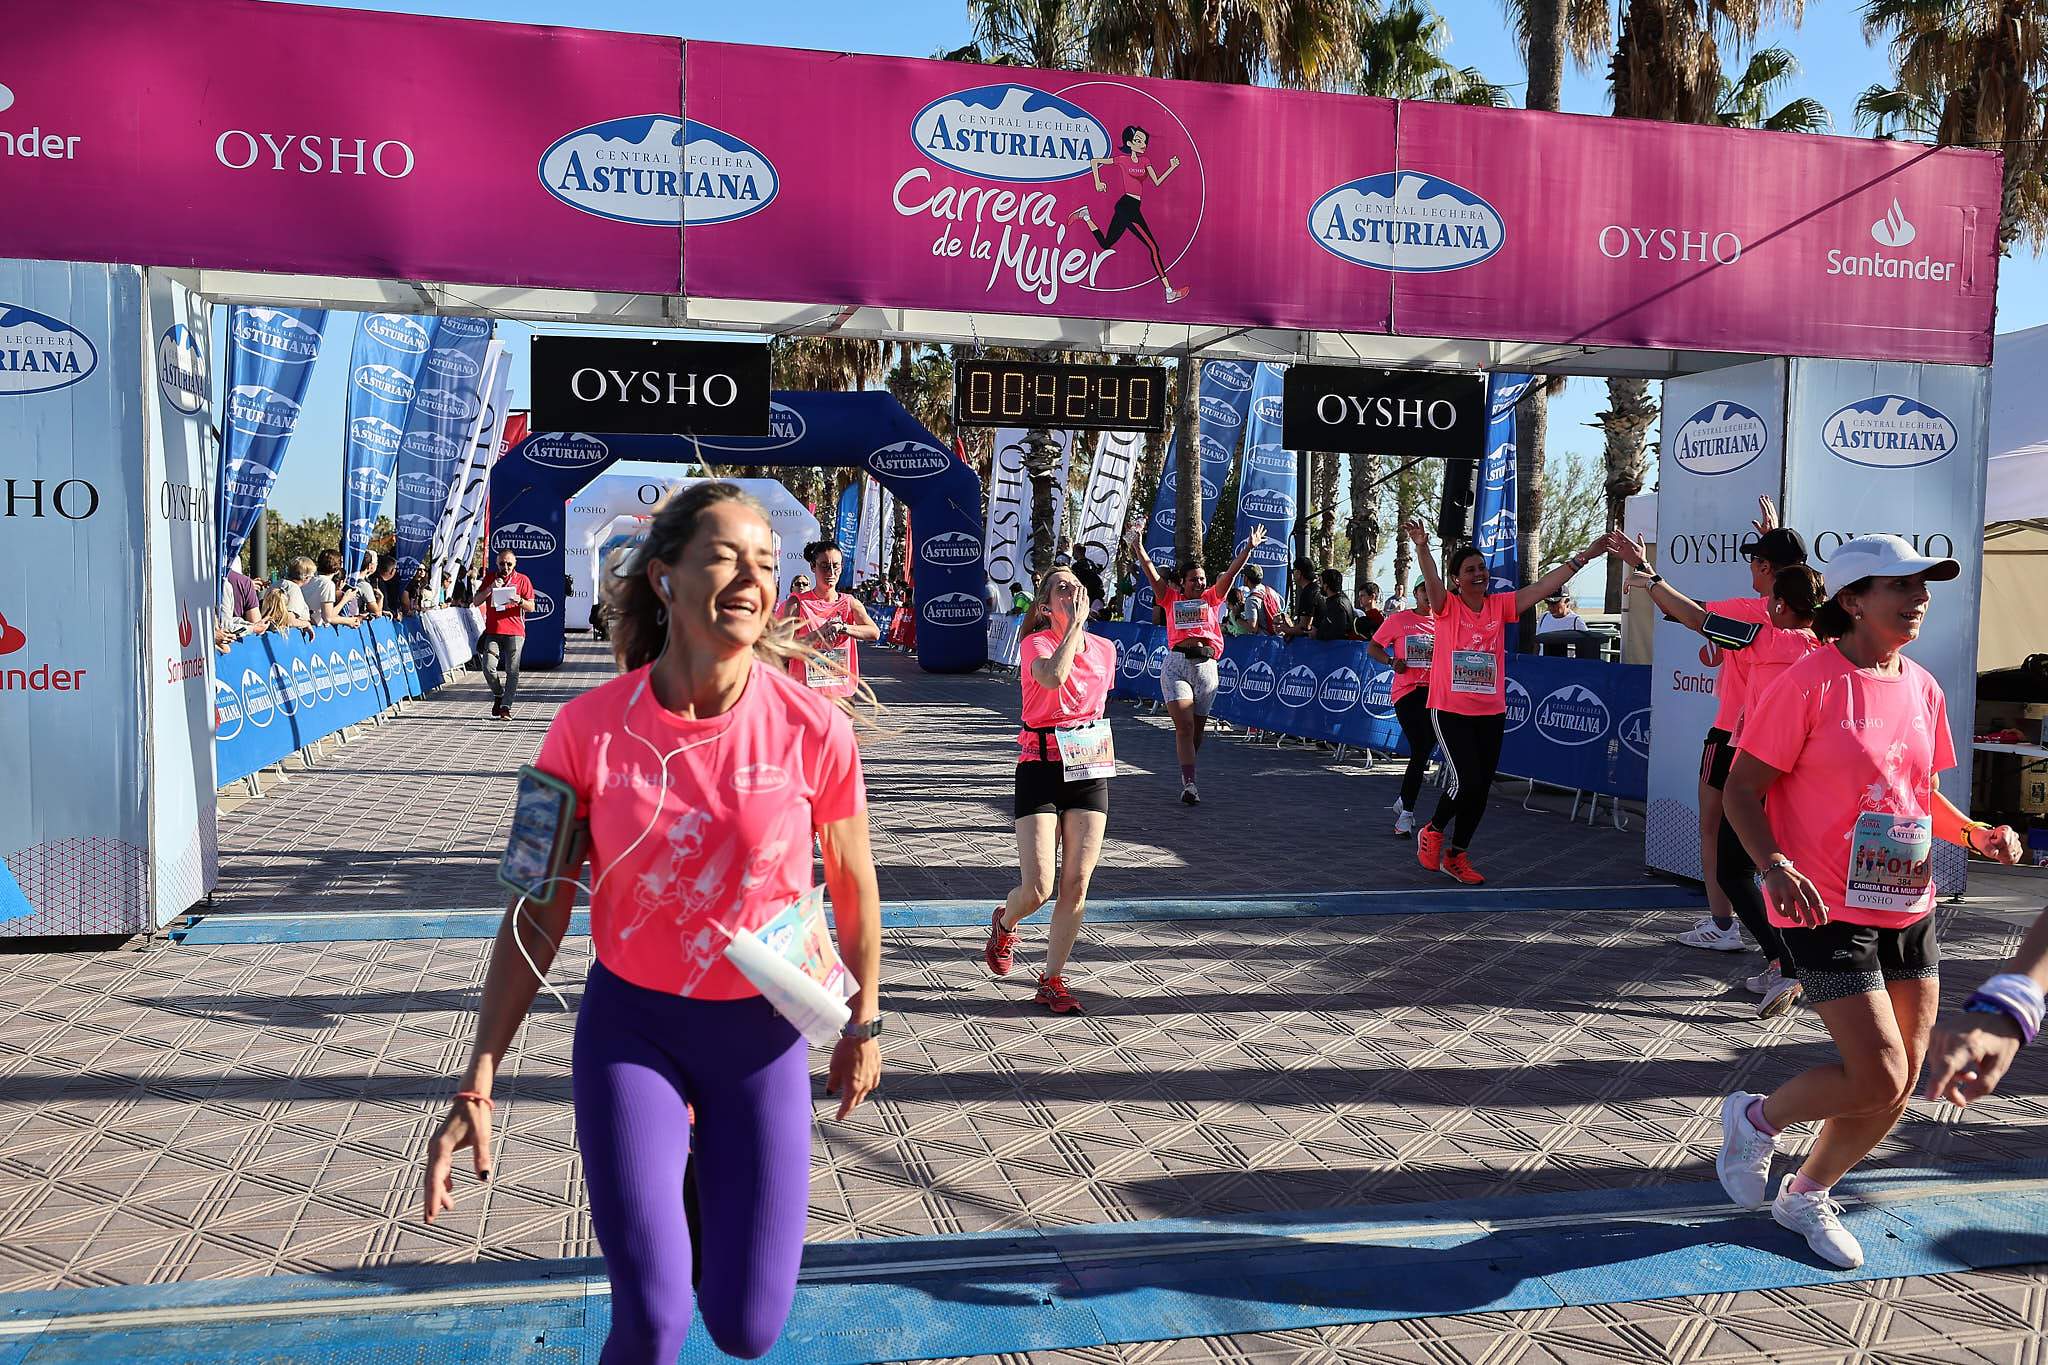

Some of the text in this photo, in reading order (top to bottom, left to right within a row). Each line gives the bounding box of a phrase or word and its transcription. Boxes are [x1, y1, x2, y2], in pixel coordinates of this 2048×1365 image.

[958, 113, 1091, 133] CENTRAL LECHERA
[926, 113, 1094, 161] ASTURIANA
[215, 129, 415, 179] OYSHO
[595, 149, 753, 169] CENTRAL LECHERA
[558, 150, 761, 201] ASTURIANA
[892, 167, 1057, 227] Carrera
[1354, 202, 1484, 220] CENTRAL LECHERA
[1322, 203, 1490, 250] ASTURIANA
[1599, 225, 1743, 266] OYSHO
[932, 222, 1117, 305] de la Mujer
[1827, 249, 1956, 283] Santander
[5, 335, 74, 346] LECHERA
[233, 321, 318, 357] ASTURIANA
[570, 367, 739, 407] OYSHO
[970, 371, 1150, 420] 00:42:40
[1200, 405, 1236, 425] STURIANA
[1316, 393, 1458, 431] OYSHO
[1693, 421, 1758, 437] CENTRAL LECHERA
[1831, 420, 1947, 451] ASTURIANA
[1853, 419, 1944, 430] CENTRAL LECHERA
[528, 443, 602, 460] ASTURIANA
[1678, 433, 1760, 460] ASTURIANA
[875, 455, 946, 470] ASTURIANA
[160, 480, 208, 524] OYSHO
[573, 506, 606, 515] OYSHO
[771, 509, 802, 517] OYSHO
[988, 444, 1027, 585] OYSHO
[493, 536, 552, 551] ASTURIANA
[925, 544, 980, 559] ASTURIANA
[786, 552, 804, 560] OYS
[926, 604, 981, 619] ASTURIANA
[167, 656, 206, 684] Santander
[1673, 670, 1713, 694] Santa
[1320, 682, 1357, 703] ASTURIANA
[1538, 703, 1601, 734] ASTURIANA
[1853, 881, 1881, 892] CARRERA
[1881, 885, 1892, 893] DE
[1858, 894, 1893, 906] OYSHO
